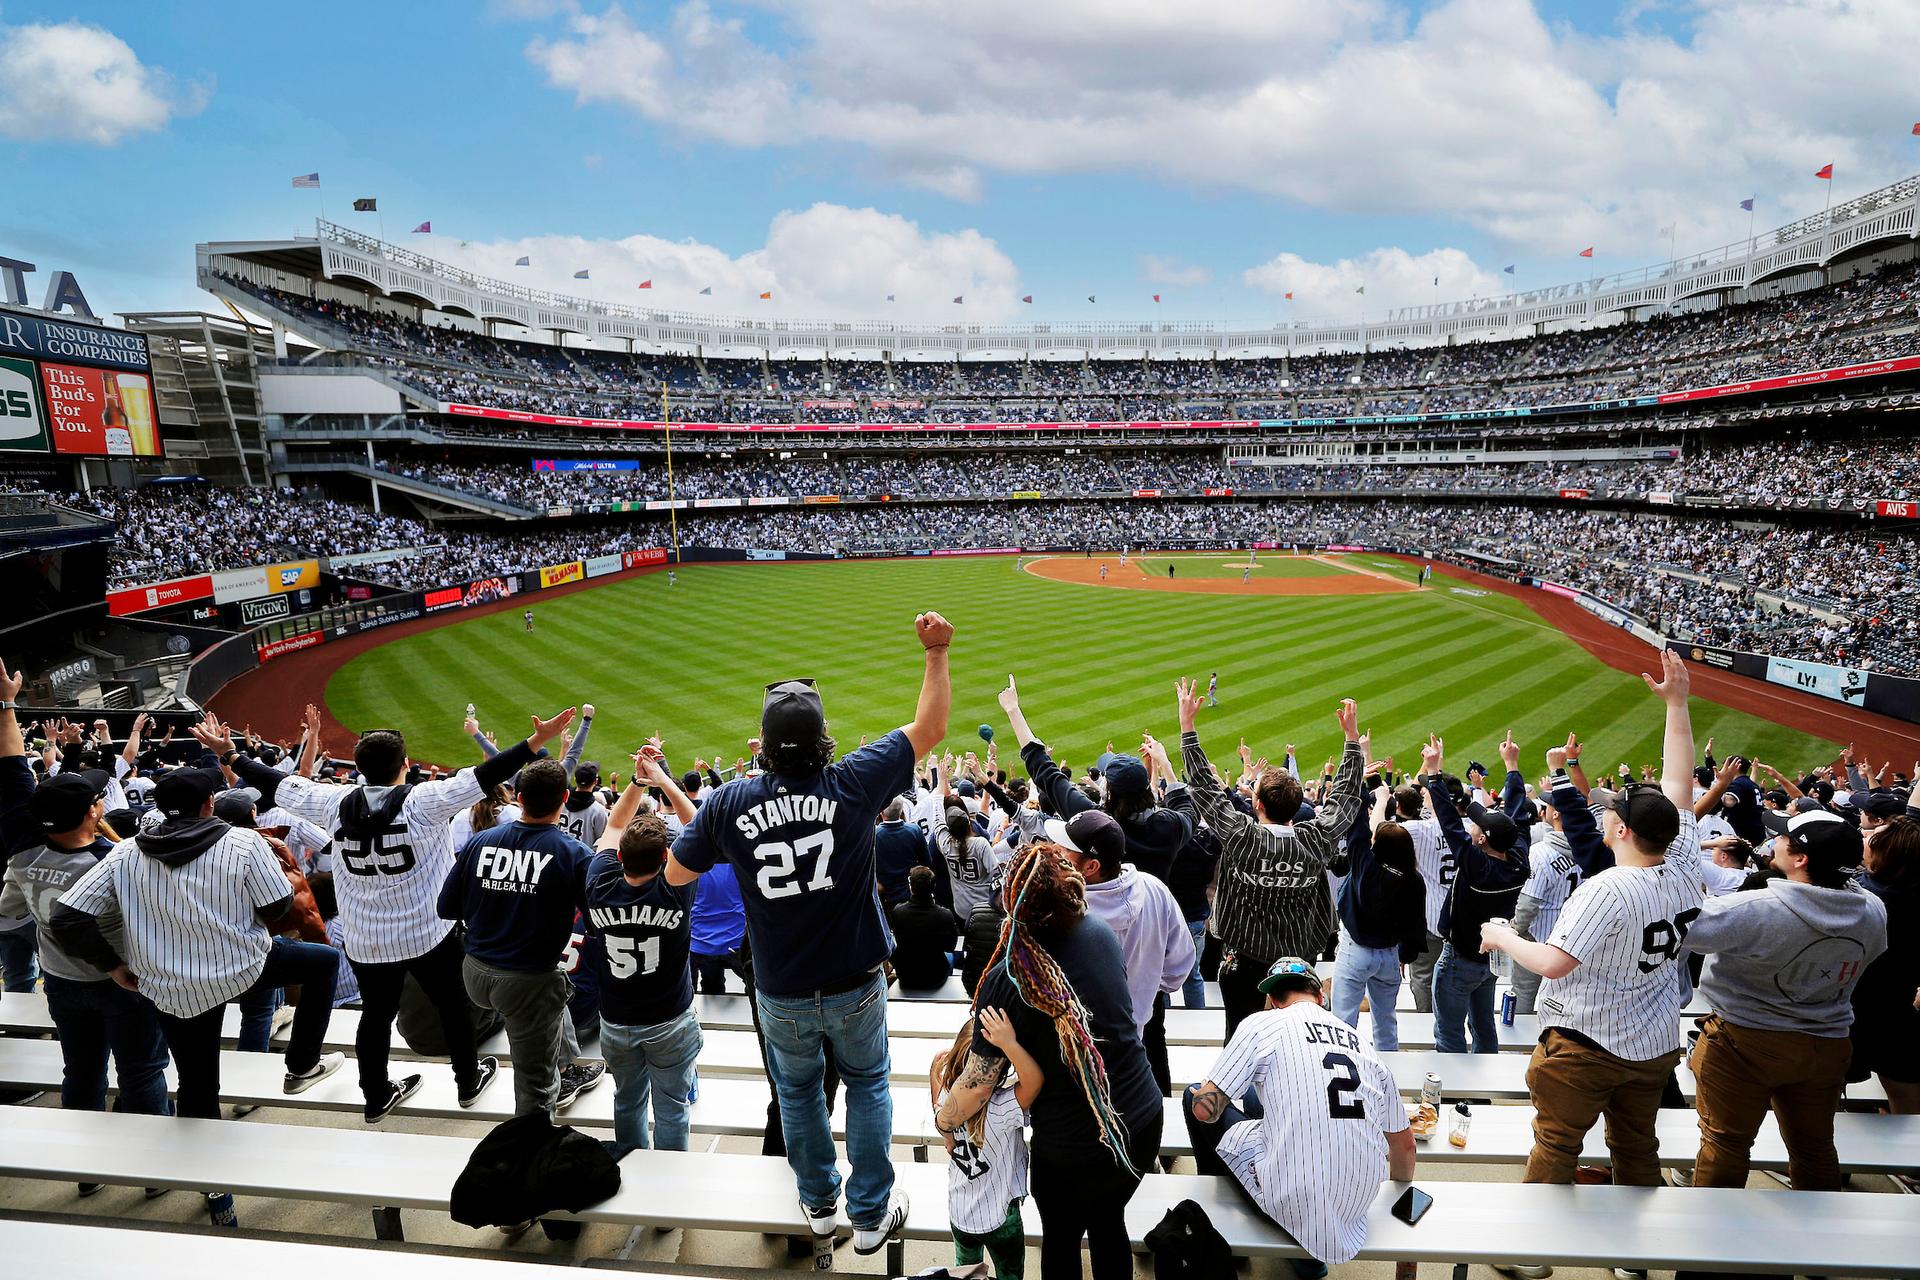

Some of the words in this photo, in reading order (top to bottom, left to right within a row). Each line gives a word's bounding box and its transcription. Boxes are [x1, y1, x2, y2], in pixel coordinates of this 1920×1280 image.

[0, 316, 34, 350] R
[44, 323, 146, 351] INSURANCE
[48, 340, 148, 366] COMPANIES
[45, 367, 85, 386] This
[49, 384, 95, 402] Bud's
[53, 401, 81, 417] For
[54, 417, 92, 433] You.
[1885, 502, 1908, 516] AVIS
[644, 550, 665, 558] WEBB
[281, 571, 299, 585] SAP
[159, 588, 182, 600] TOYOTA
[193, 606, 219, 620] FedEx
[244, 599, 287, 619] VIKING
[735, 795, 838, 839] STANTON
[334, 822, 416, 876] 25
[1435, 835, 1450, 851] JE
[476, 846, 553, 885] FDNY
[753, 828, 836, 900] 27
[949, 856, 981, 883] 99
[1259, 858, 1304, 873] LOS
[27, 867, 72, 885] STIEF
[520, 882, 537, 894] N.Y.
[590, 905, 683, 930] WILLIAMS
[604, 933, 660, 979] 51
[1304, 1021, 1361, 1053] JETER
[1321, 1051, 1366, 1120] 2
